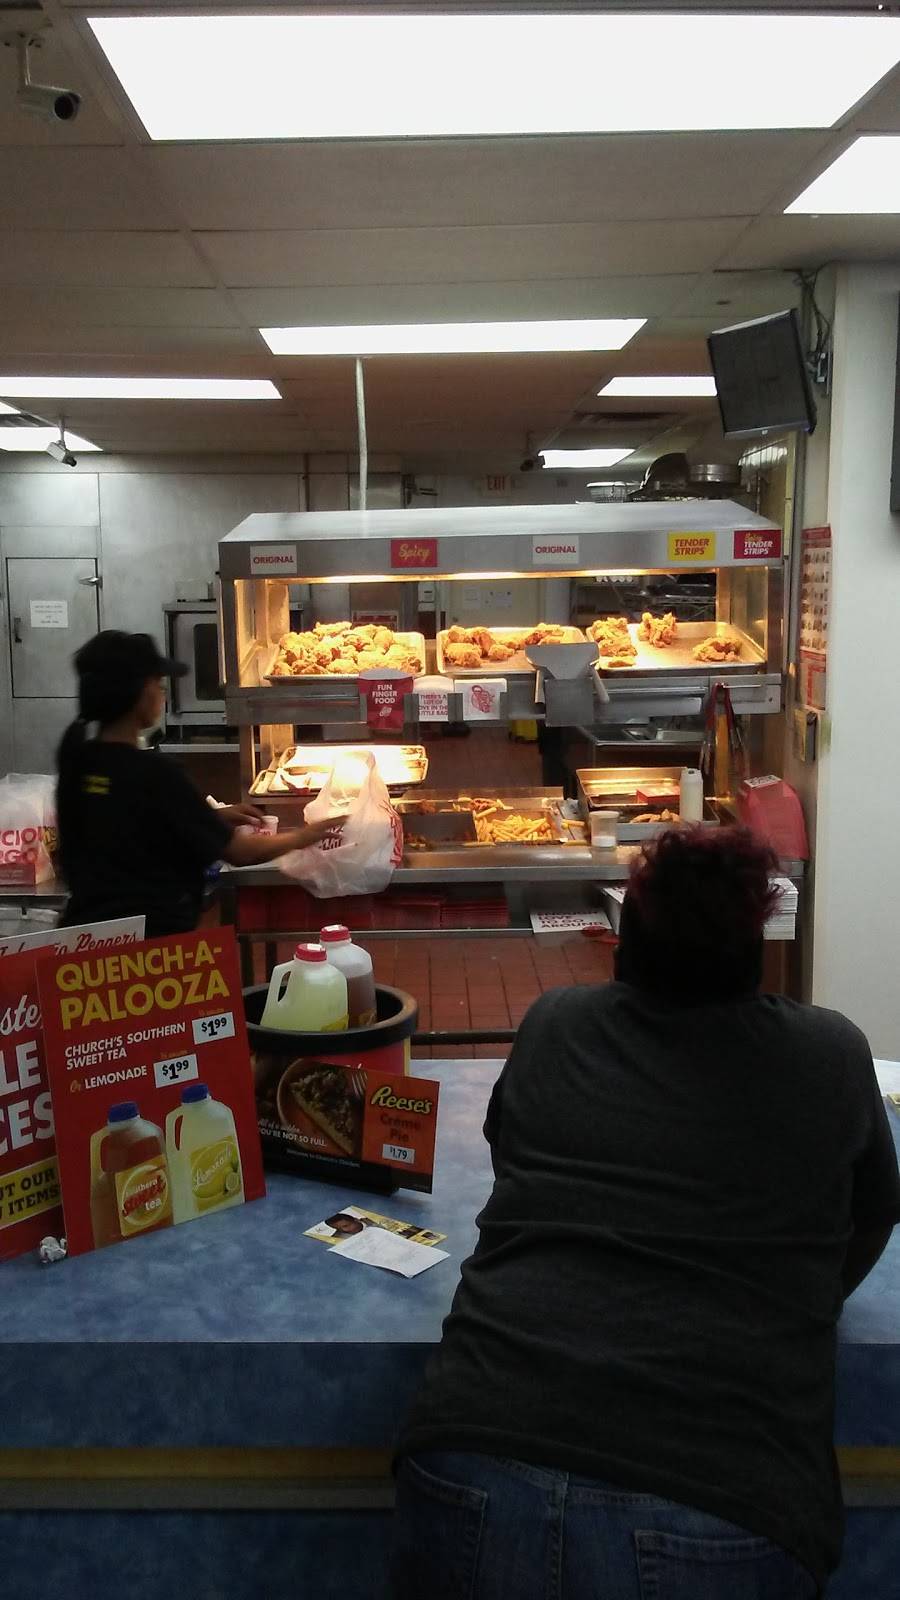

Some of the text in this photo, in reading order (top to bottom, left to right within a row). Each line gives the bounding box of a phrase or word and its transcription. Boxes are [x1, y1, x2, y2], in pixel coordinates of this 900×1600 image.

[535, 545, 577, 554] ORIGINAL
[675, 538, 710, 548] TENDER
[398, 544, 431, 561] Spicy
[674, 547, 705, 556] STRIPS
[253, 555, 294, 565] ORIGINAL
[372, 690, 398, 698] FINGER
[55, 940, 222, 992] QUENCH-A-
[60, 969, 230, 1031] PALOOZA
[64, 1022, 187, 1058] CHURCH'S SOUTHERN
[66, 1047, 127, 1070] SWEET TEA
[84, 1065, 148, 1089] LEMONADE
[370, 1085, 433, 1114] Reese's
[282, 1132, 298, 1141] NOT
[299, 1134, 309, 1144] SO
[390, 1128, 409, 1142] Pie
[21, 1168, 55, 1190] OUR
[145, 1198, 162, 1211] tea
